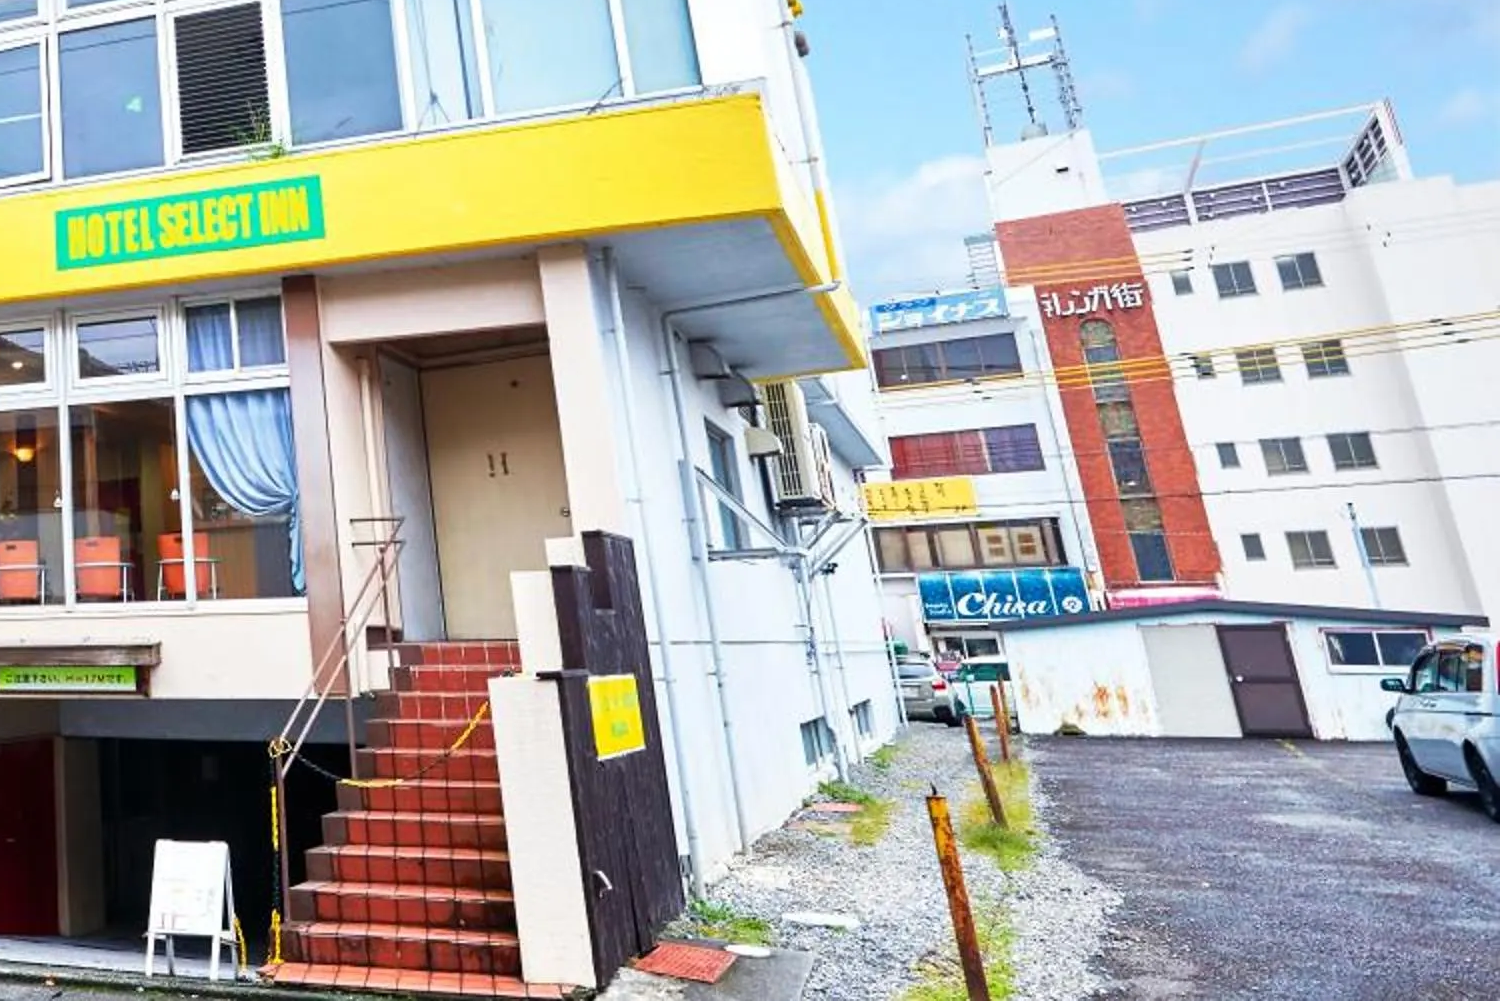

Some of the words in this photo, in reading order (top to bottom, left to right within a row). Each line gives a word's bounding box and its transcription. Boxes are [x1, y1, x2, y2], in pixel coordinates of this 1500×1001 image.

[67, 207, 154, 260] HOTEL
[158, 192, 253, 248] SELECT
[258, 186, 309, 235] INN
